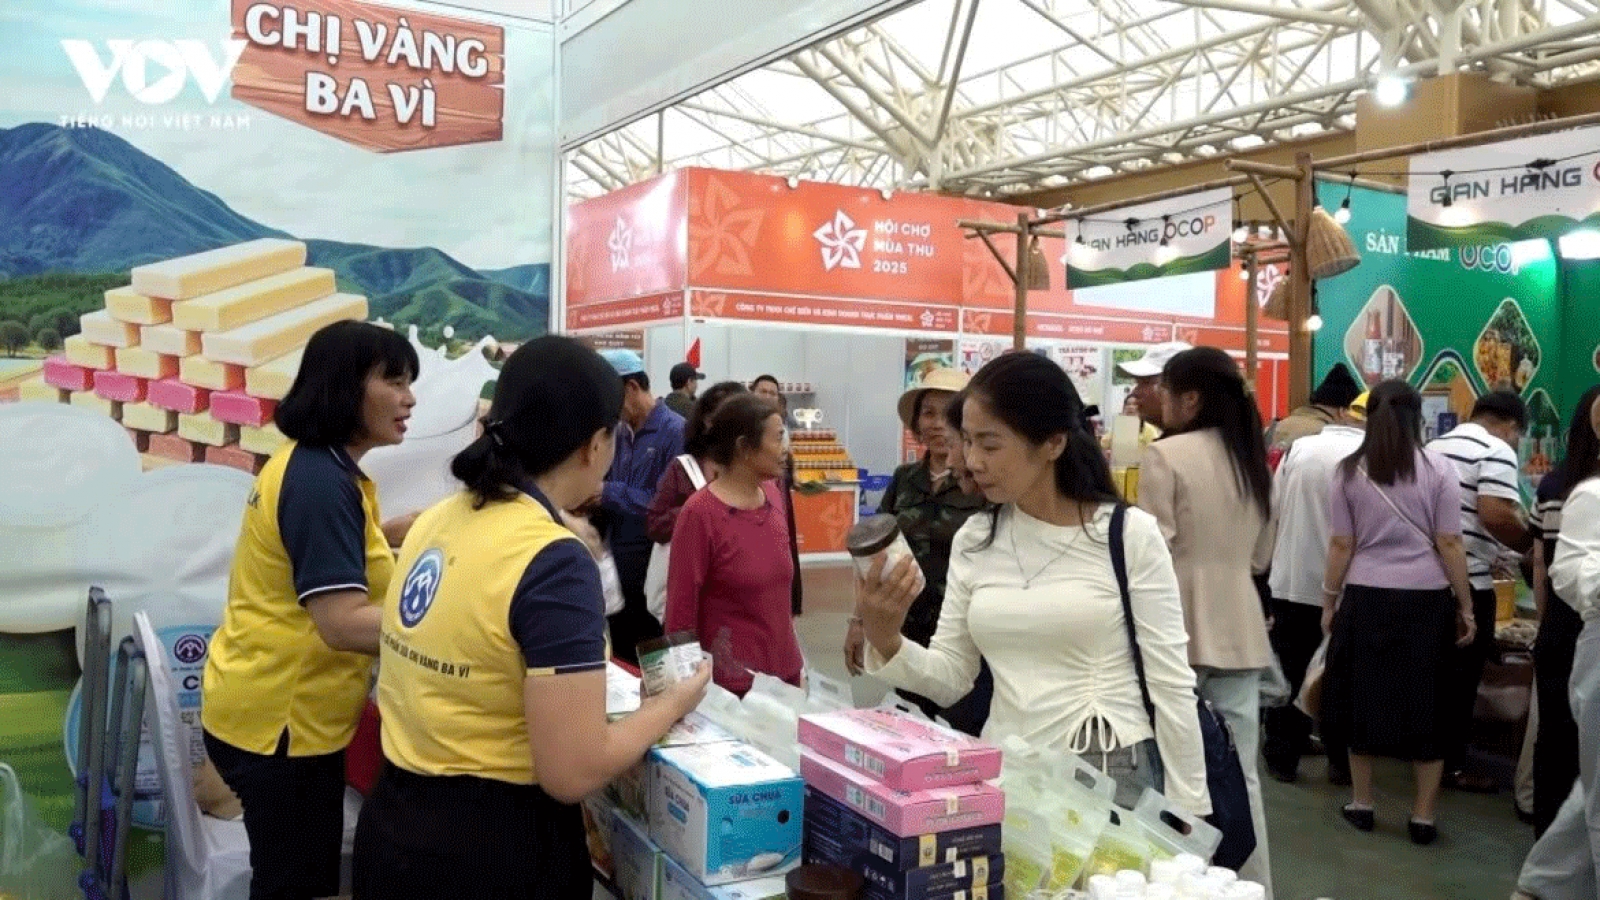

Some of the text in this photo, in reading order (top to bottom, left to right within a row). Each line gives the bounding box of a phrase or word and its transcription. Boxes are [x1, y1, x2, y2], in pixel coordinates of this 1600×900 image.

[245, 3, 488, 78] CHỊ VÀNG
[305, 71, 437, 127] BA VÌ
[1164, 215, 1216, 240] OCOP
[908, 242, 935, 258] THU
[1365, 228, 1400, 255] SẢN
[873, 259, 908, 275] 2025
[441, 661, 455, 676] BA
